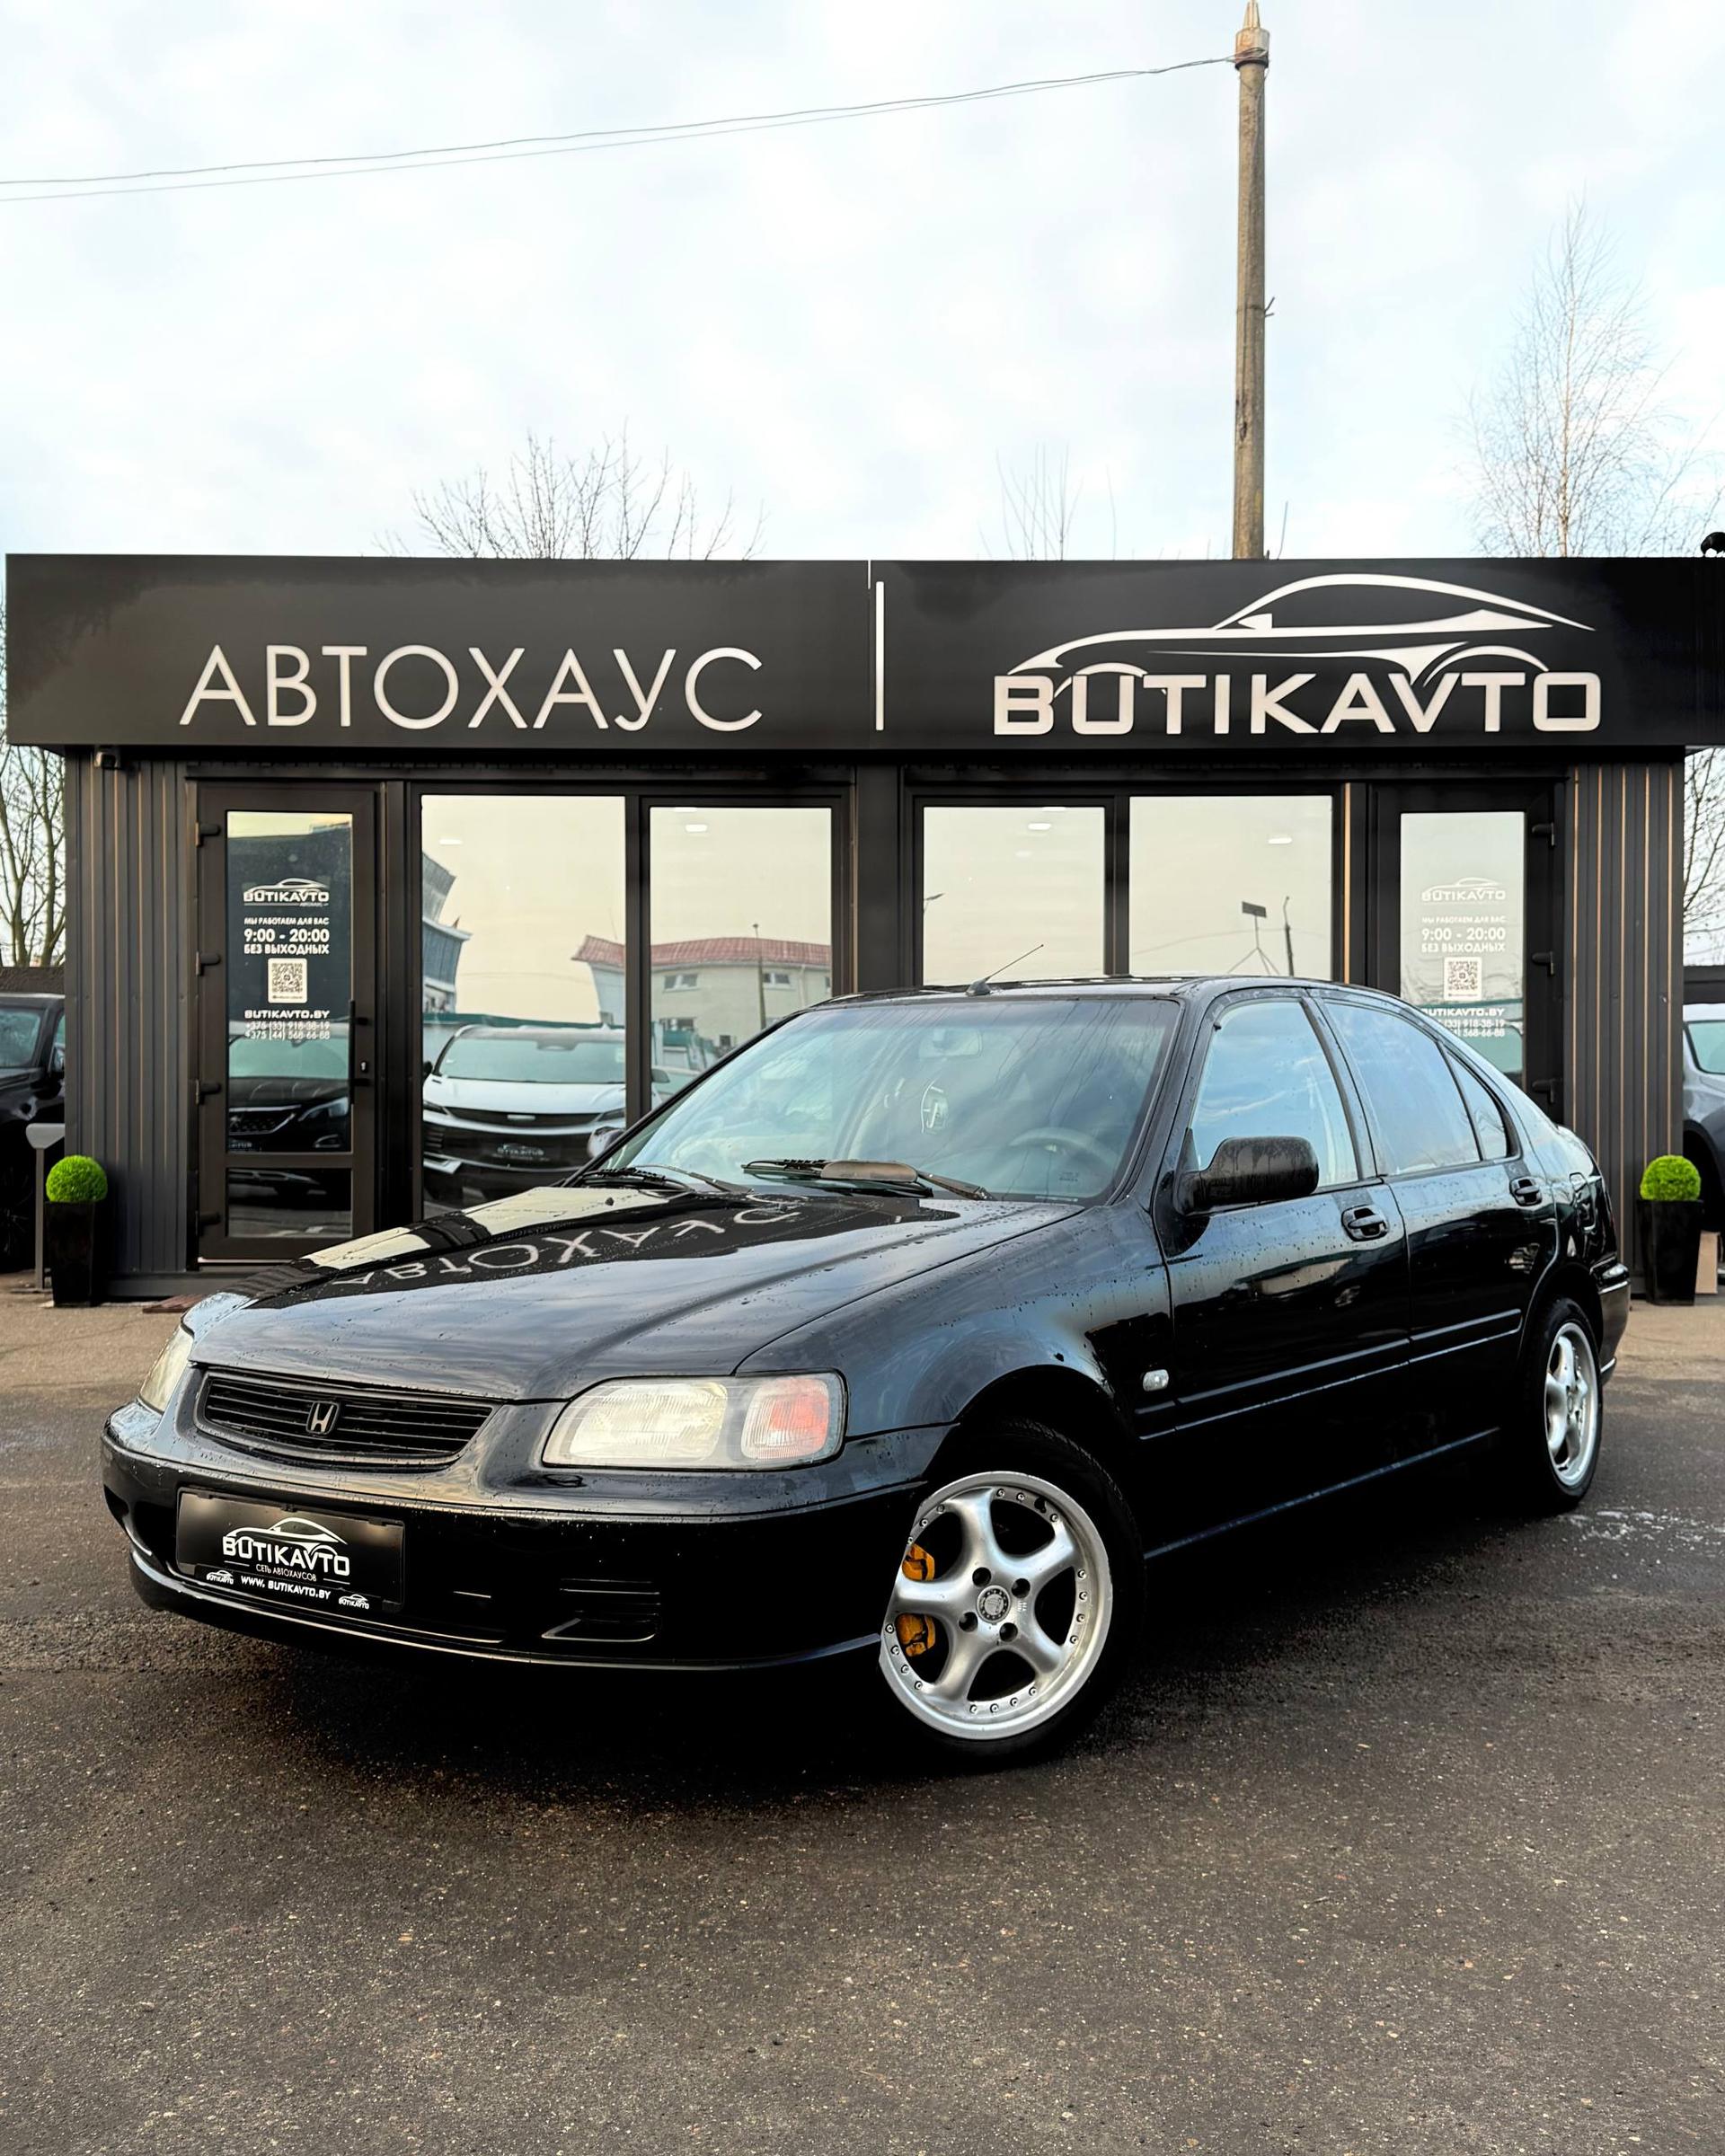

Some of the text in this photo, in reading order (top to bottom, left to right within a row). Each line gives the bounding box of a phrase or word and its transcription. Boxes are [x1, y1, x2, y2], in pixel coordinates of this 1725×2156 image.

[179, 644, 763, 732] АВТОХАУС
[993, 671, 1602, 736] BUTIKAVTO
[243, 891, 330, 902] BUTIKAVTO
[1421, 891, 1506, 901] BUTIKAVTO
[243, 917, 258, 925] МЫ
[259, 917, 296, 925] РАБОТАЕМ
[314, 917, 330, 925] ВАС
[243, 928, 276, 942] 9:00
[289, 928, 330, 942] 20:00
[1421, 927, 1452, 941] 9:00
[1466, 926, 1506, 941] 20:00
[243, 943, 330, 955] БЕЗ ВЫХОДНЫХ
[1421, 942, 1506, 953] БЕЗ ВЫХОДНЫХ
[244, 1010, 330, 1019] BUTIKAVTO.BY
[223, 1536, 350, 1577] BUTIKAVTO
[255, 1563, 317, 1582] СЕТЬ АВТОХАУСОВ
[241, 1575, 332, 1600] WWW. BUTIKAVTO.BY
